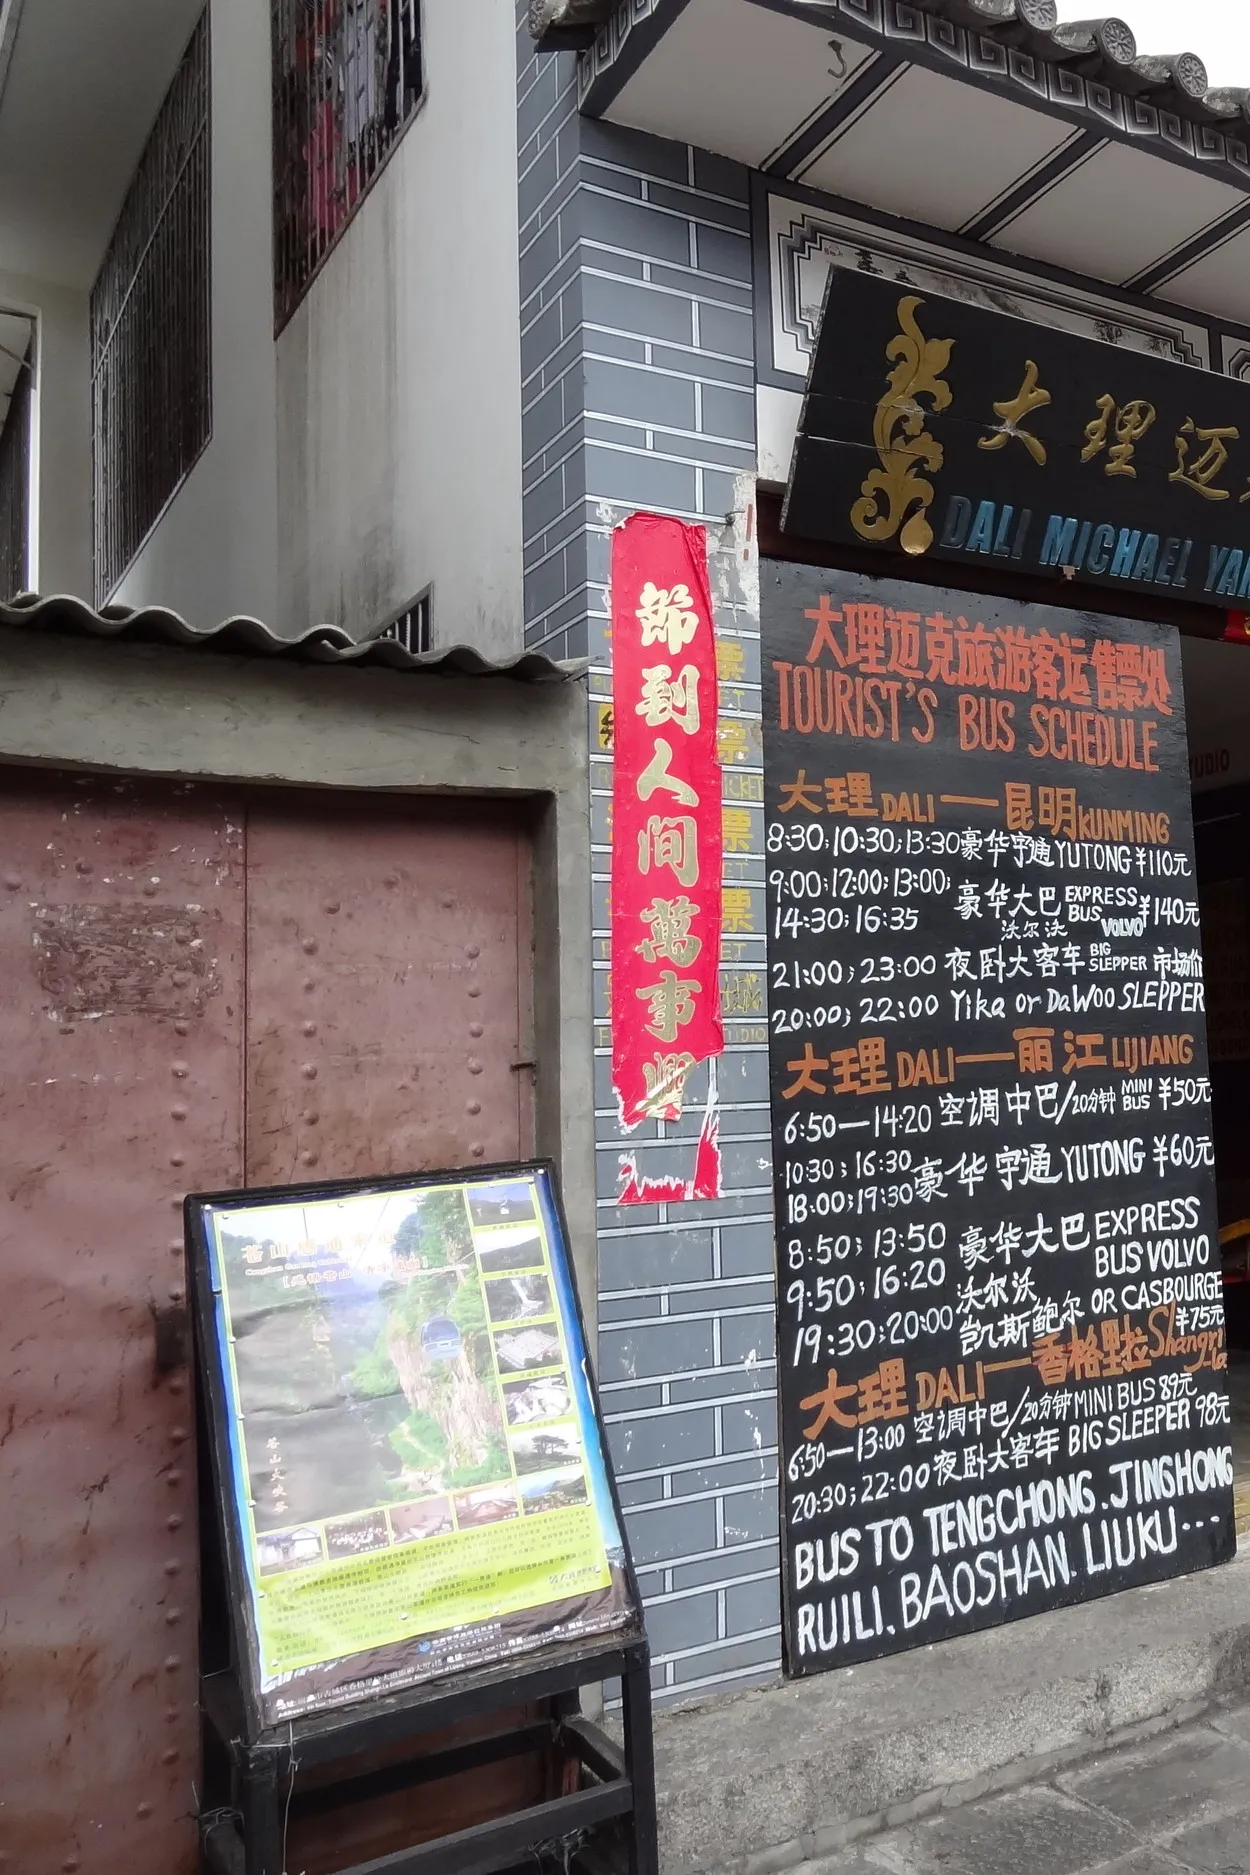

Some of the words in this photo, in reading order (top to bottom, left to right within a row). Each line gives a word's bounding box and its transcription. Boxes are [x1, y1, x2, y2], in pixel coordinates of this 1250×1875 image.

[940, 494, 1033, 560] DALI
[1038, 514, 1194, 588] MICHAEL
[803, 595, 1174, 715] 大理迈克旅游客运售票处
[773, 661, 938, 744] TOURIST'S
[959, 693, 1016, 753] BUS
[1028, 704, 1161, 772] SCHEDULE
[777, 769, 880, 818] 大理
[881, 792, 935, 823] DALI
[1005, 782, 1077, 842] 昆明
[1055, 842, 1134, 874] YUTONG
[1065, 885, 1138, 908] EXPRESS
[1067, 904, 1101, 923] BUS
[1100, 916, 1145, 938] VOLVO
[1088, 955, 1149, 973] SLEPPER
[1089, 942, 1112, 958] BIG
[1014, 993, 1044, 1014] or
[1119, 980, 1206, 1014] SLEPPER
[781, 1035, 892, 1100] 大理
[896, 1046, 957, 1088] DALI
[1012, 1026, 1108, 1075] 丽江
[1112, 1033, 1195, 1075] LIJIANG
[1120, 1077, 1153, 1098] MINI
[1121, 1093, 1152, 1112] BUS
[1060, 1138, 1146, 1184] YUTONG
[957, 1212, 1092, 1272] 豪华大巴
[1094, 1196, 1202, 1241] EXPRESS
[1094, 1238, 1143, 1279] BUS
[1145, 1232, 1211, 1273] VOLVO
[1090, 1286, 1118, 1314] OR
[1119, 1270, 1225, 1312] CASBOURGE
[799, 1357, 911, 1442] 大理
[915, 1358, 988, 1412] DALI
[1073, 1386, 1115, 1418] MINI
[1116, 1376, 1157, 1412] BUS
[1067, 1420, 1102, 1456] BIG
[1105, 1397, 1191, 1446] SLEEPER
[795, 1529, 862, 1590] BUS
[864, 1515, 914, 1567] TO
